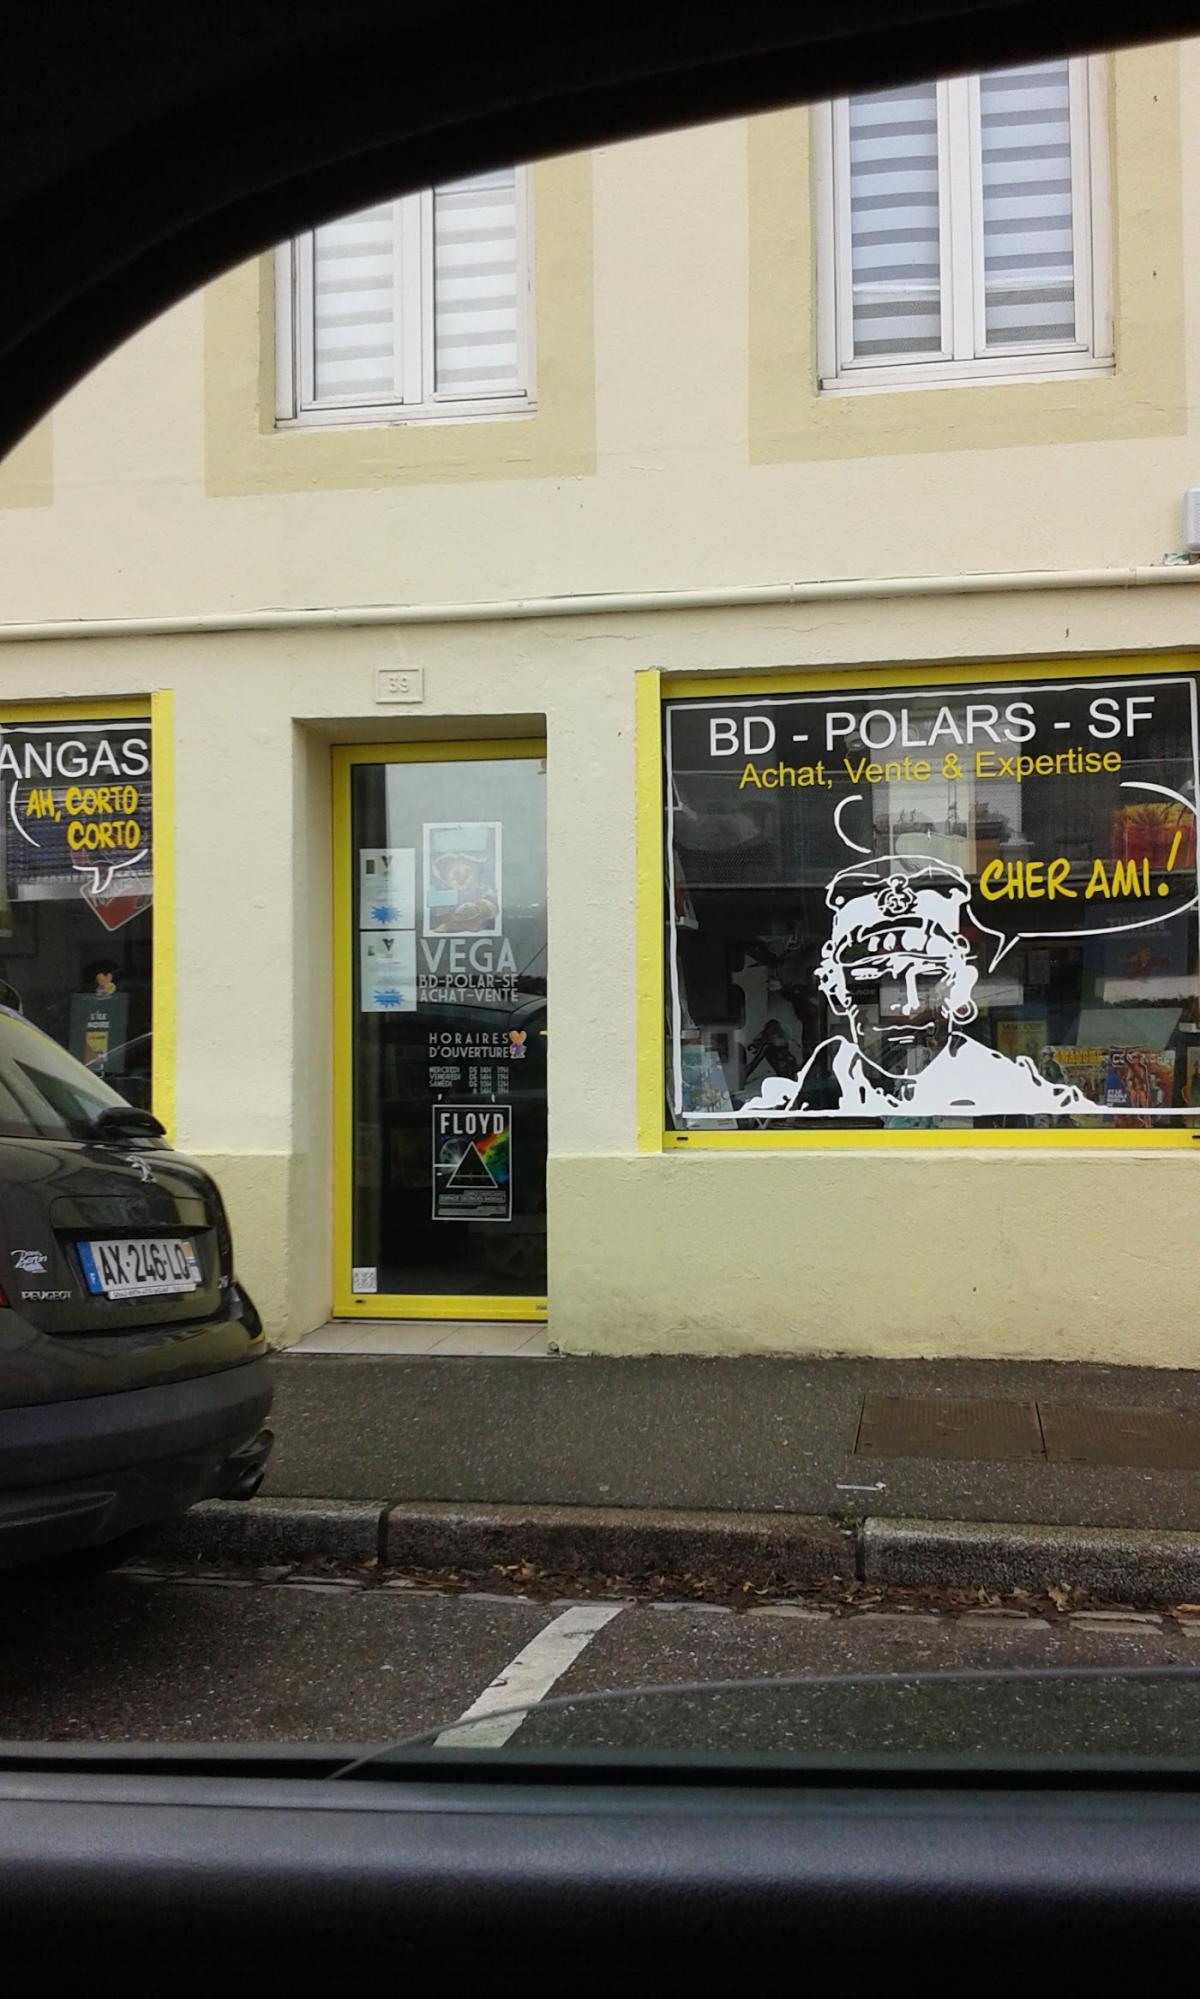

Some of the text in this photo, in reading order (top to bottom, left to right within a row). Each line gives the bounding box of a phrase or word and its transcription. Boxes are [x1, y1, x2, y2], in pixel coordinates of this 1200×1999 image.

[709, 716, 775, 756] BD
[826, 703, 1036, 751] POLARS
[1088, 696, 1154, 738] SF
[739, 748, 1122, 790] Achat, Vente & Expertise
[26, 785, 138, 822] AH, CORTO
[67, 820, 141, 850] CORTO
[979, 858, 1077, 900] CHER
[420, 938, 517, 973] VEGA
[420, 974, 518, 988] BD-POLAR-SF
[420, 988, 518, 1002] ACHAT-VENTE
[429, 1033, 508, 1044] HORAIRES
[429, 1046, 509, 1058] D'OUVERTURE
[440, 1113, 504, 1134] FLOYD
[21, 1290, 72, 1300] PEUGEOT
